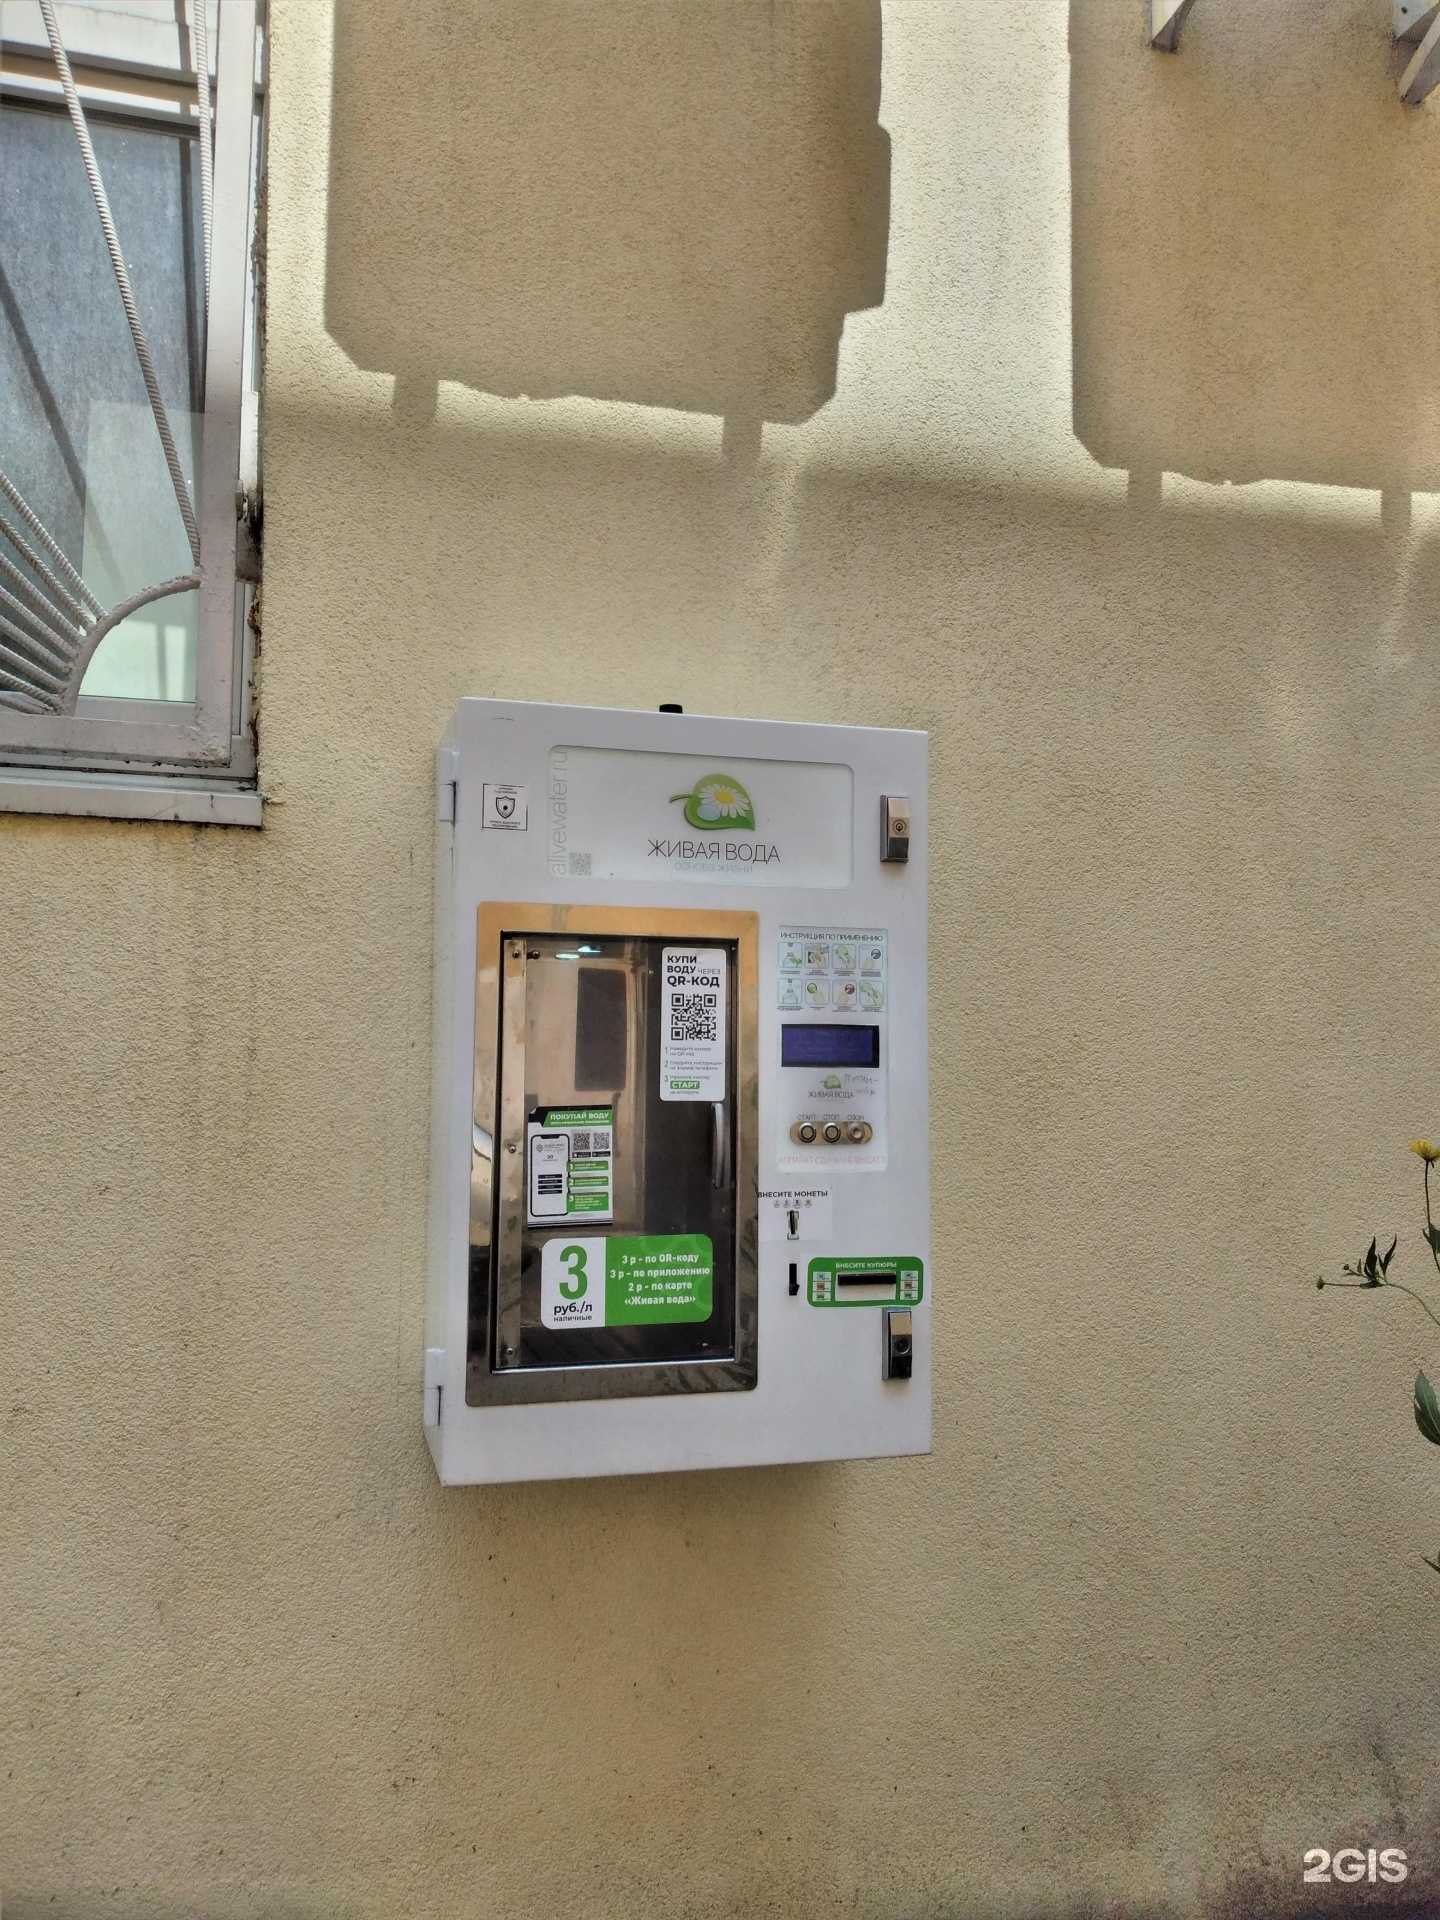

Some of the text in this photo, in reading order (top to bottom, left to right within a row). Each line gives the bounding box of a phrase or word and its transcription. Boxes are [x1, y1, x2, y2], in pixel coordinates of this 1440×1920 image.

[647, 839, 781, 864] ЖИВАЯ ВОДА
[667, 955, 697, 964] КУПИ
[667, 965, 696, 975] ВОДУ
[667, 975, 720, 988] QR-КОД
[671, 1081, 698, 1089] СТАРТ
[550, 1112, 609, 1121] ПОКУПАЙ ВОДУ
[622, 1255, 628, 1264] 3
[629, 1257, 636, 1265] р
[559, 1245, 588, 1300] 3
[610, 1269, 616, 1278] 3
[618, 1271, 625, 1280] р
[633, 1270, 645, 1278] по
[647, 1267, 711, 1278] приложению
[628, 1282, 634, 1291] 2
[636, 1284, 642, 1292] р
[665, 1282, 692, 1291] карте
[553, 1301, 593, 1315] руб./л
[553, 1314, 592, 1322] наличные
